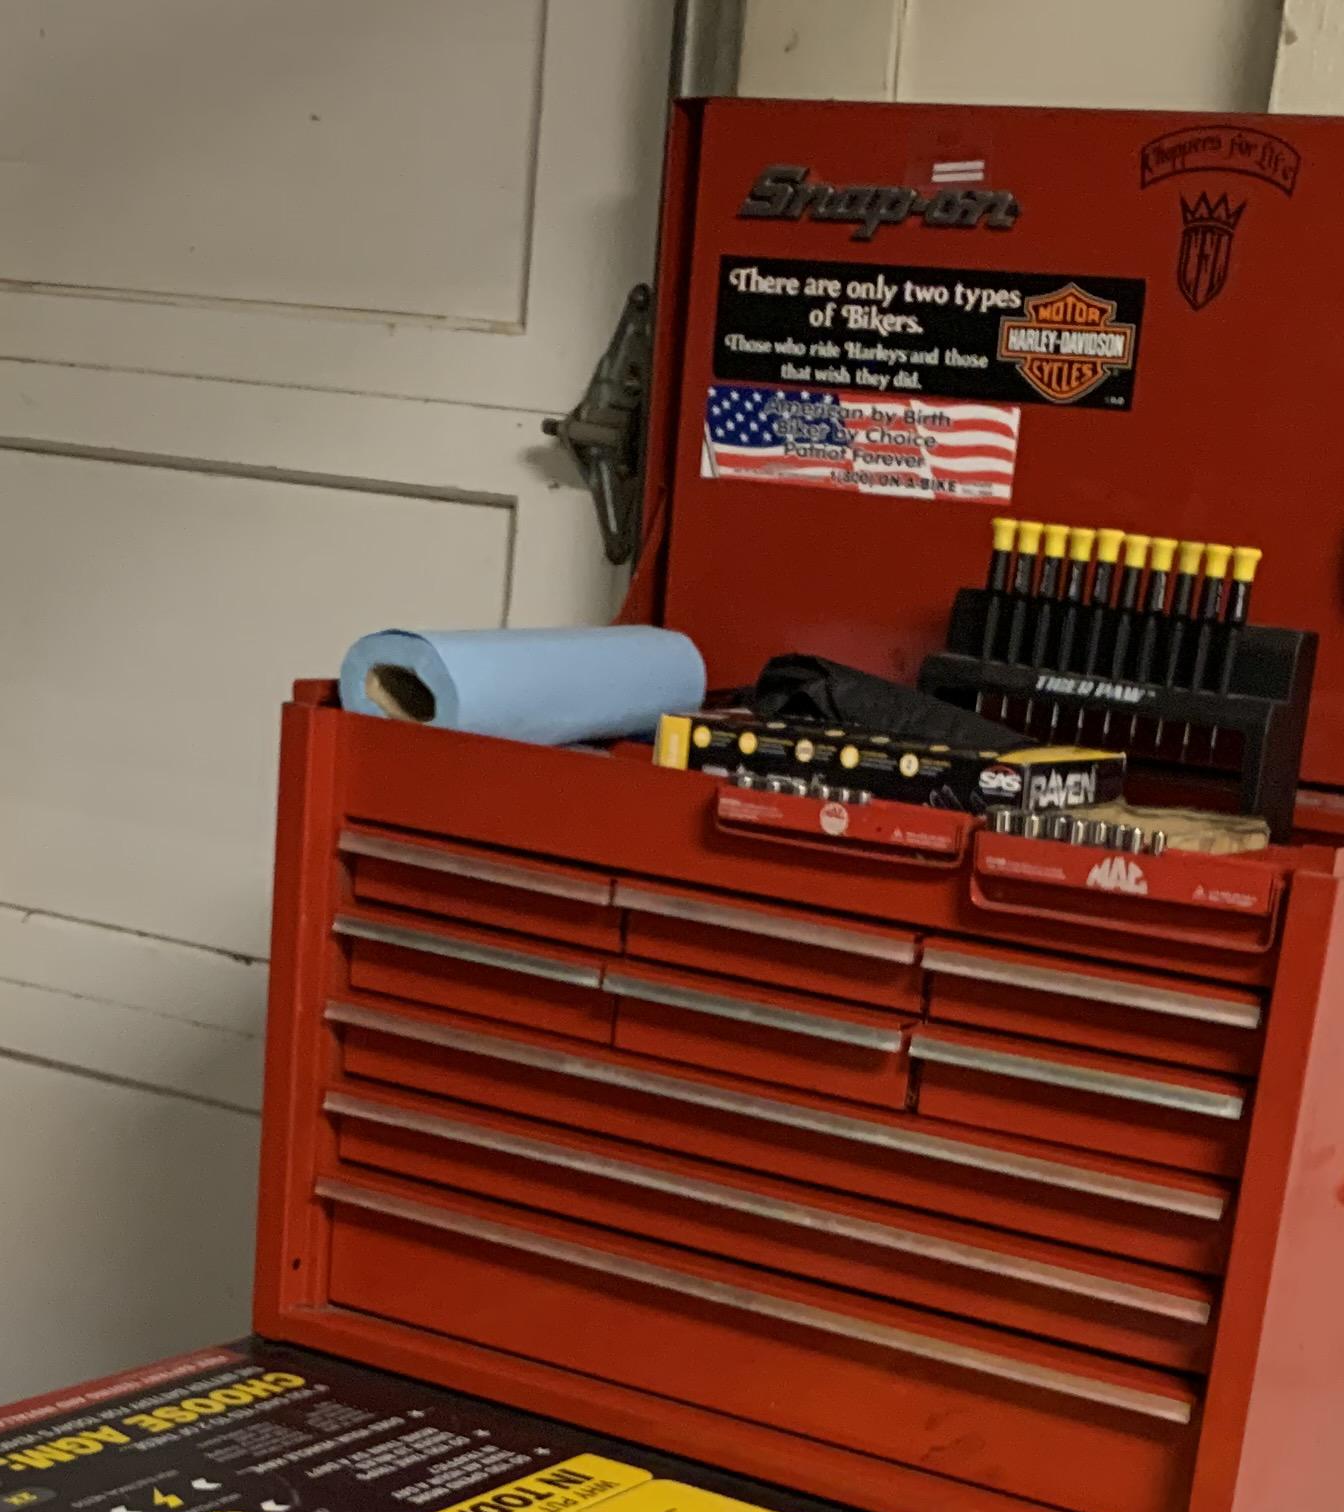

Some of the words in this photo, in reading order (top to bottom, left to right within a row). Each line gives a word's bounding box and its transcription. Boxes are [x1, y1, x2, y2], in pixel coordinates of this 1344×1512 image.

[737, 166, 1021, 242] Snap-on
[729, 266, 799, 296] There
[804, 277, 841, 298] are
[846, 274, 897, 308] only
[903, 280, 949, 304] two
[955, 282, 1022, 312] types
[809, 303, 836, 328] of
[841, 305, 924, 337] Bikers.
[1038, 297, 1100, 322] MOTOR
[725, 334, 772, 354] Those
[775, 337, 806, 356] who
[810, 341, 840, 358] ride
[844, 342, 907, 365] Harleys
[910, 346, 939, 365] and
[945, 348, 988, 368] those
[1008, 328, 1125, 357] HARLEY-DAVIDSON
[781, 363, 811, 381] that
[815, 365, 851, 384] wish
[856, 367, 890, 390] they
[893, 371, 922, 389] did.
[1033, 361, 1092, 391] CYCLES
[764, 399, 863, 421] American
[871, 405, 897, 423] by
[904, 409, 951, 427] Birth
[777, 419, 830, 439] Biker
[835, 424, 858, 445] by
[865, 427, 936, 449] Choice
[783, 441, 845, 460] Patriot
[853, 448, 924, 467] Forever
[1029, 765, 1096, 809] RAVEN
[1086, 856, 1148, 895] MAC
[117, 1372, 313, 1432] CHOOSE
[537, 1469, 593, 1489] IN
[569, 1479, 621, 1499] WHY
[535, 1496, 581, 1512] PUT
